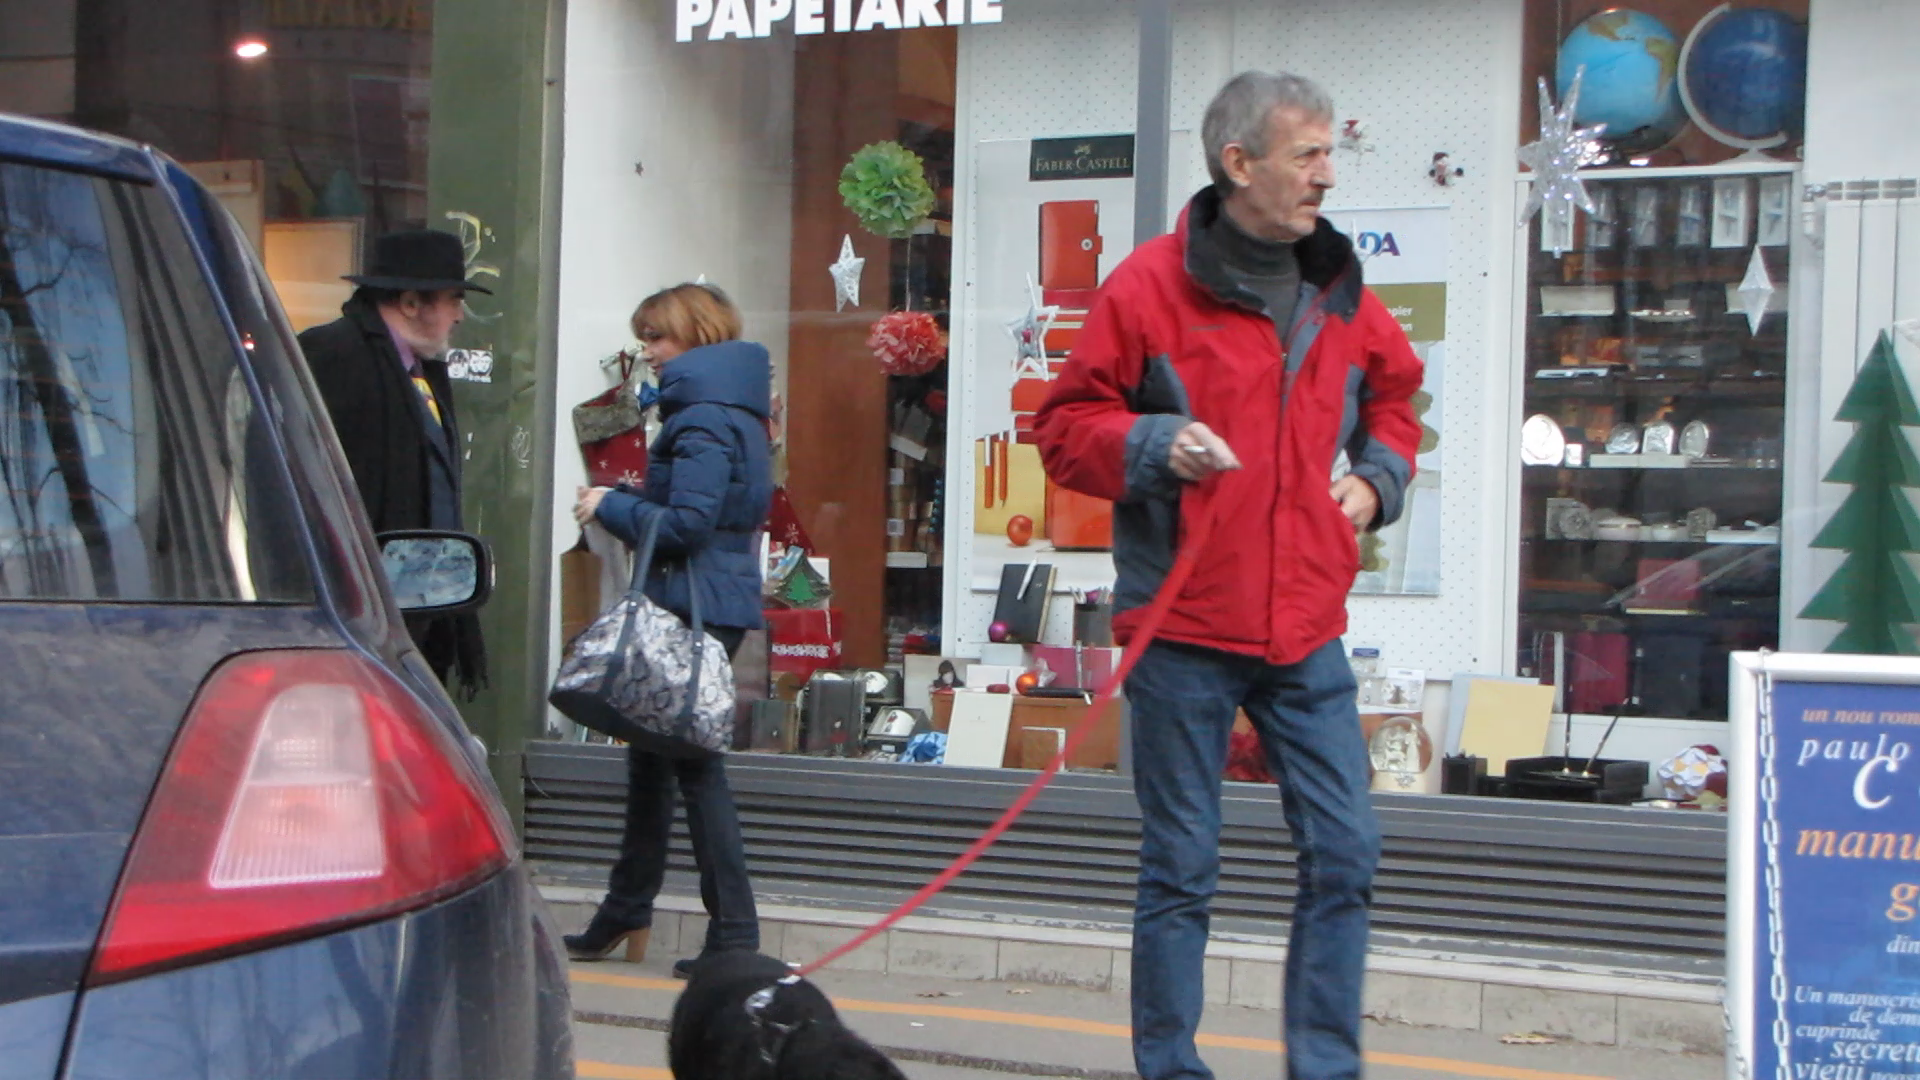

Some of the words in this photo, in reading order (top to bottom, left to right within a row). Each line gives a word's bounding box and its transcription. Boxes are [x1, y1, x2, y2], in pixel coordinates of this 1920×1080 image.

[675, 0, 1003, 42] PAPETARIE
[1802, 709, 1829, 723] un
[1834, 710, 1874, 724] nou
[1797, 732, 1911, 767] paulo
[1794, 985, 1823, 1003] Un
[1849, 1006, 1875, 1024] de
[1796, 1022, 1882, 1043] cuprinde
